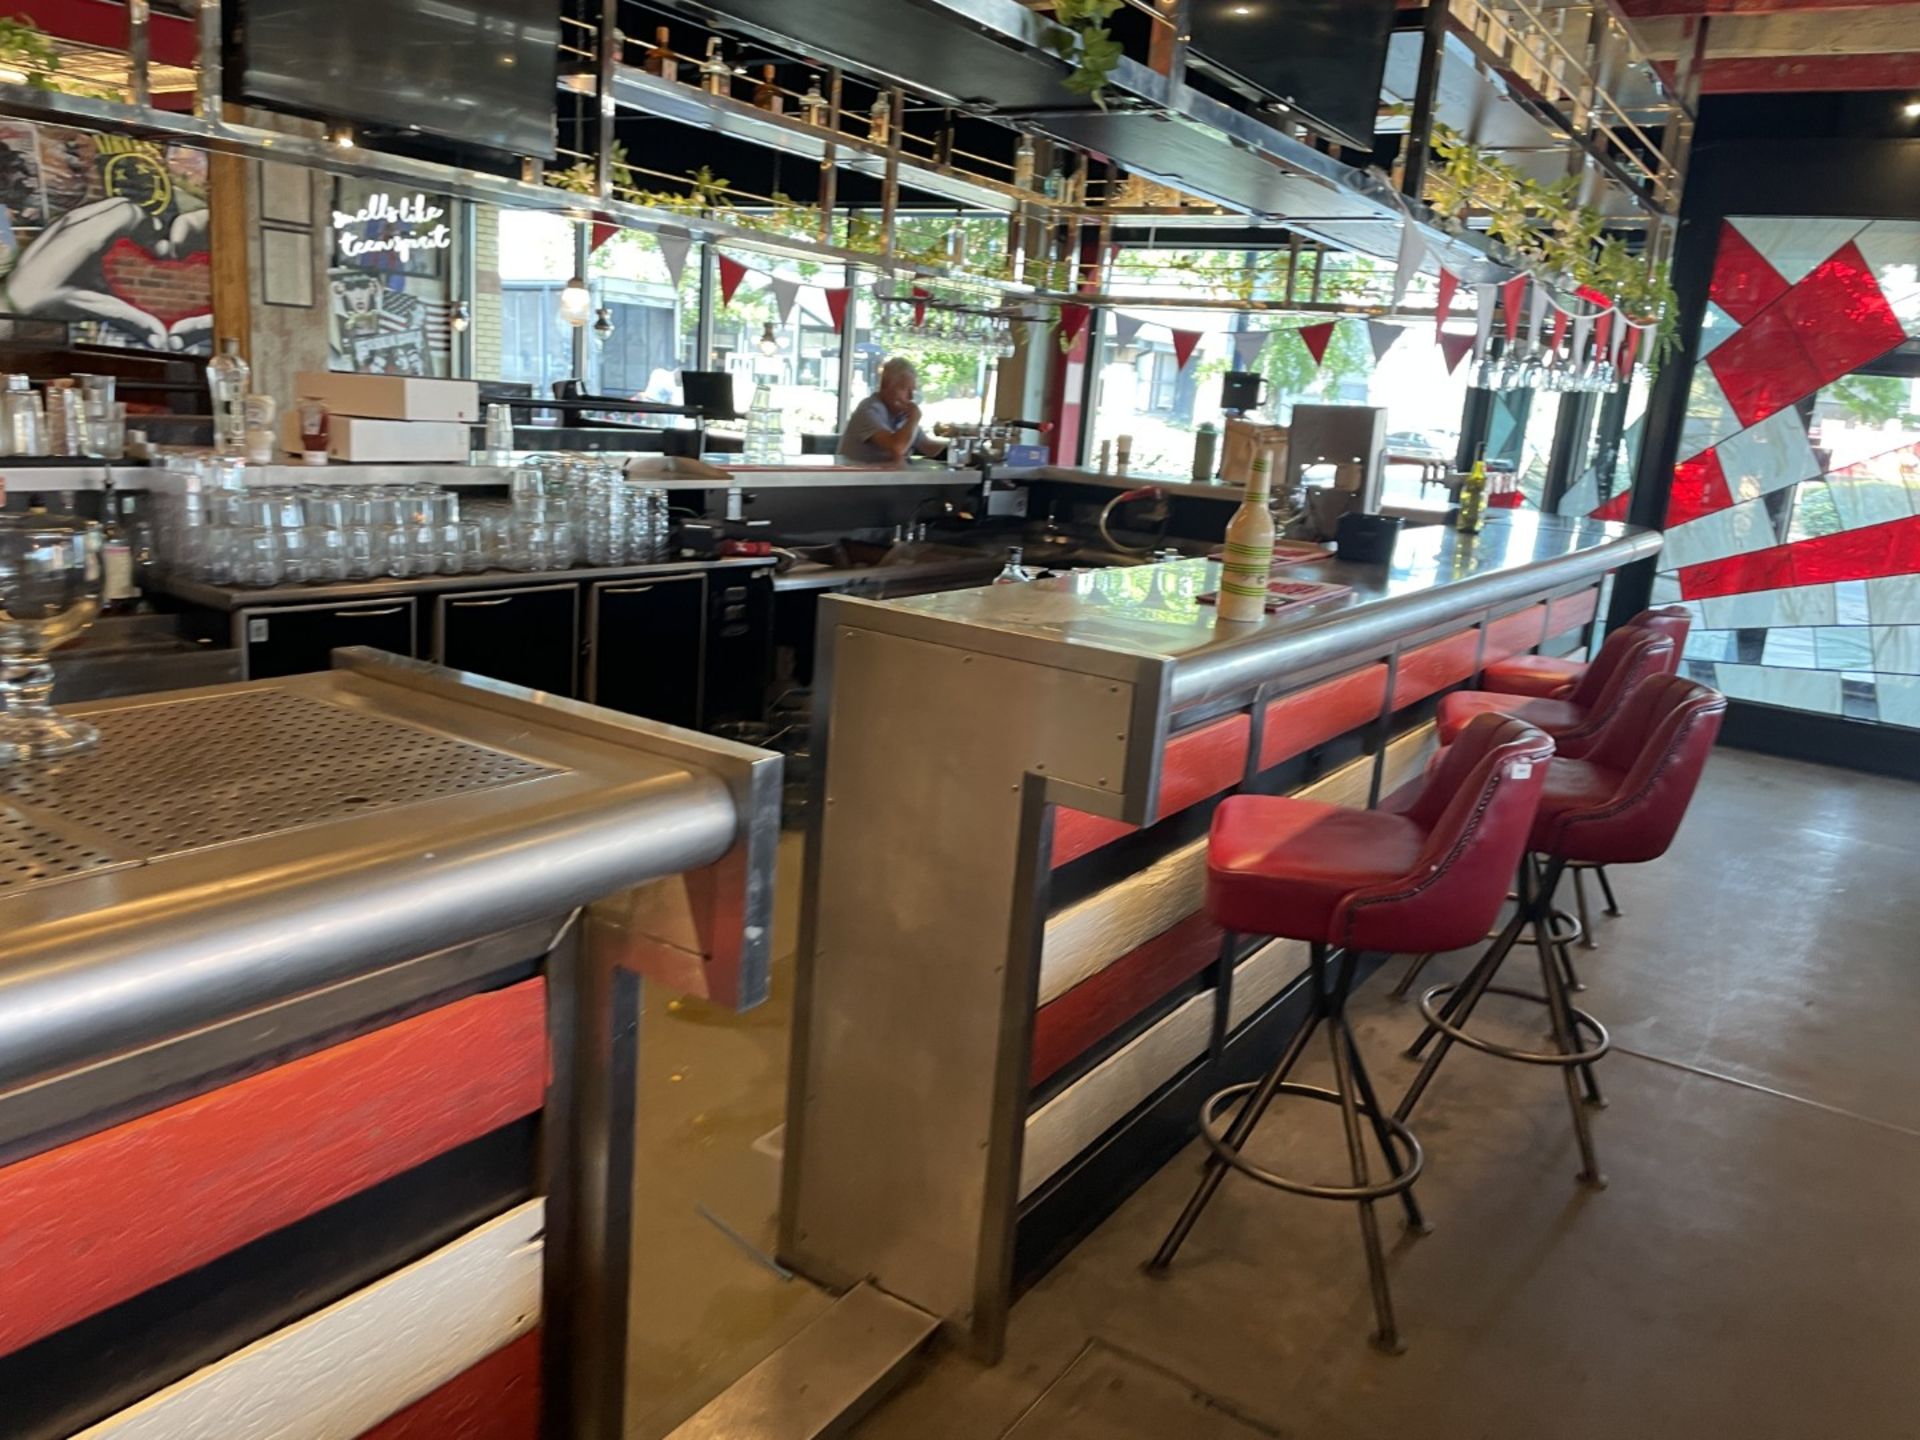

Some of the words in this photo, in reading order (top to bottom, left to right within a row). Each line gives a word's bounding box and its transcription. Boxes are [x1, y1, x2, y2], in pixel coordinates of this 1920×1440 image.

[399, 194, 444, 223] like
[338, 232, 393, 257] teen
[393, 224, 451, 263] spirit
